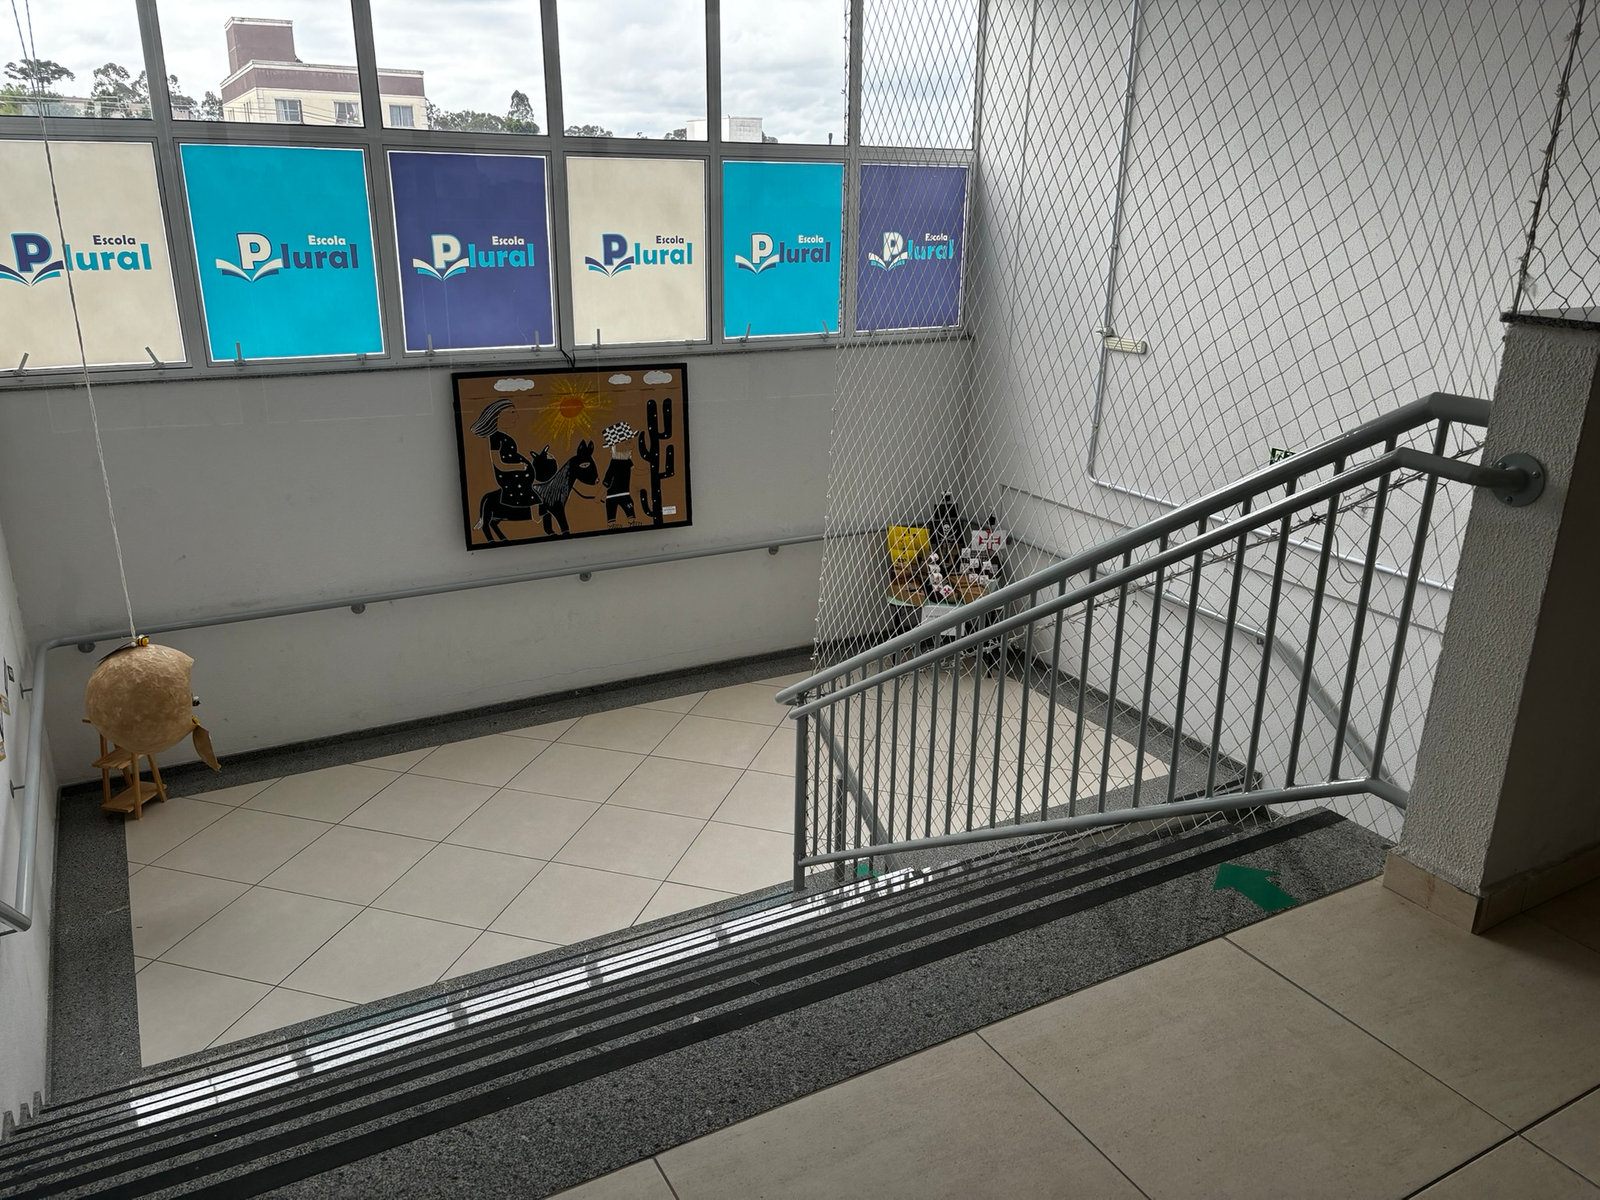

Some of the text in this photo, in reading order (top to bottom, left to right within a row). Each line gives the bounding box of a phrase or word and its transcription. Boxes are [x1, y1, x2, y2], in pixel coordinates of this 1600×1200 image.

[93, 235, 136, 246] Escola
[308, 235, 347, 246] Escola
[492, 235, 525, 246] Escola
[656, 235, 685, 245] Escola
[798, 234, 824, 244] Escola
[925, 233, 948, 242] Escola
